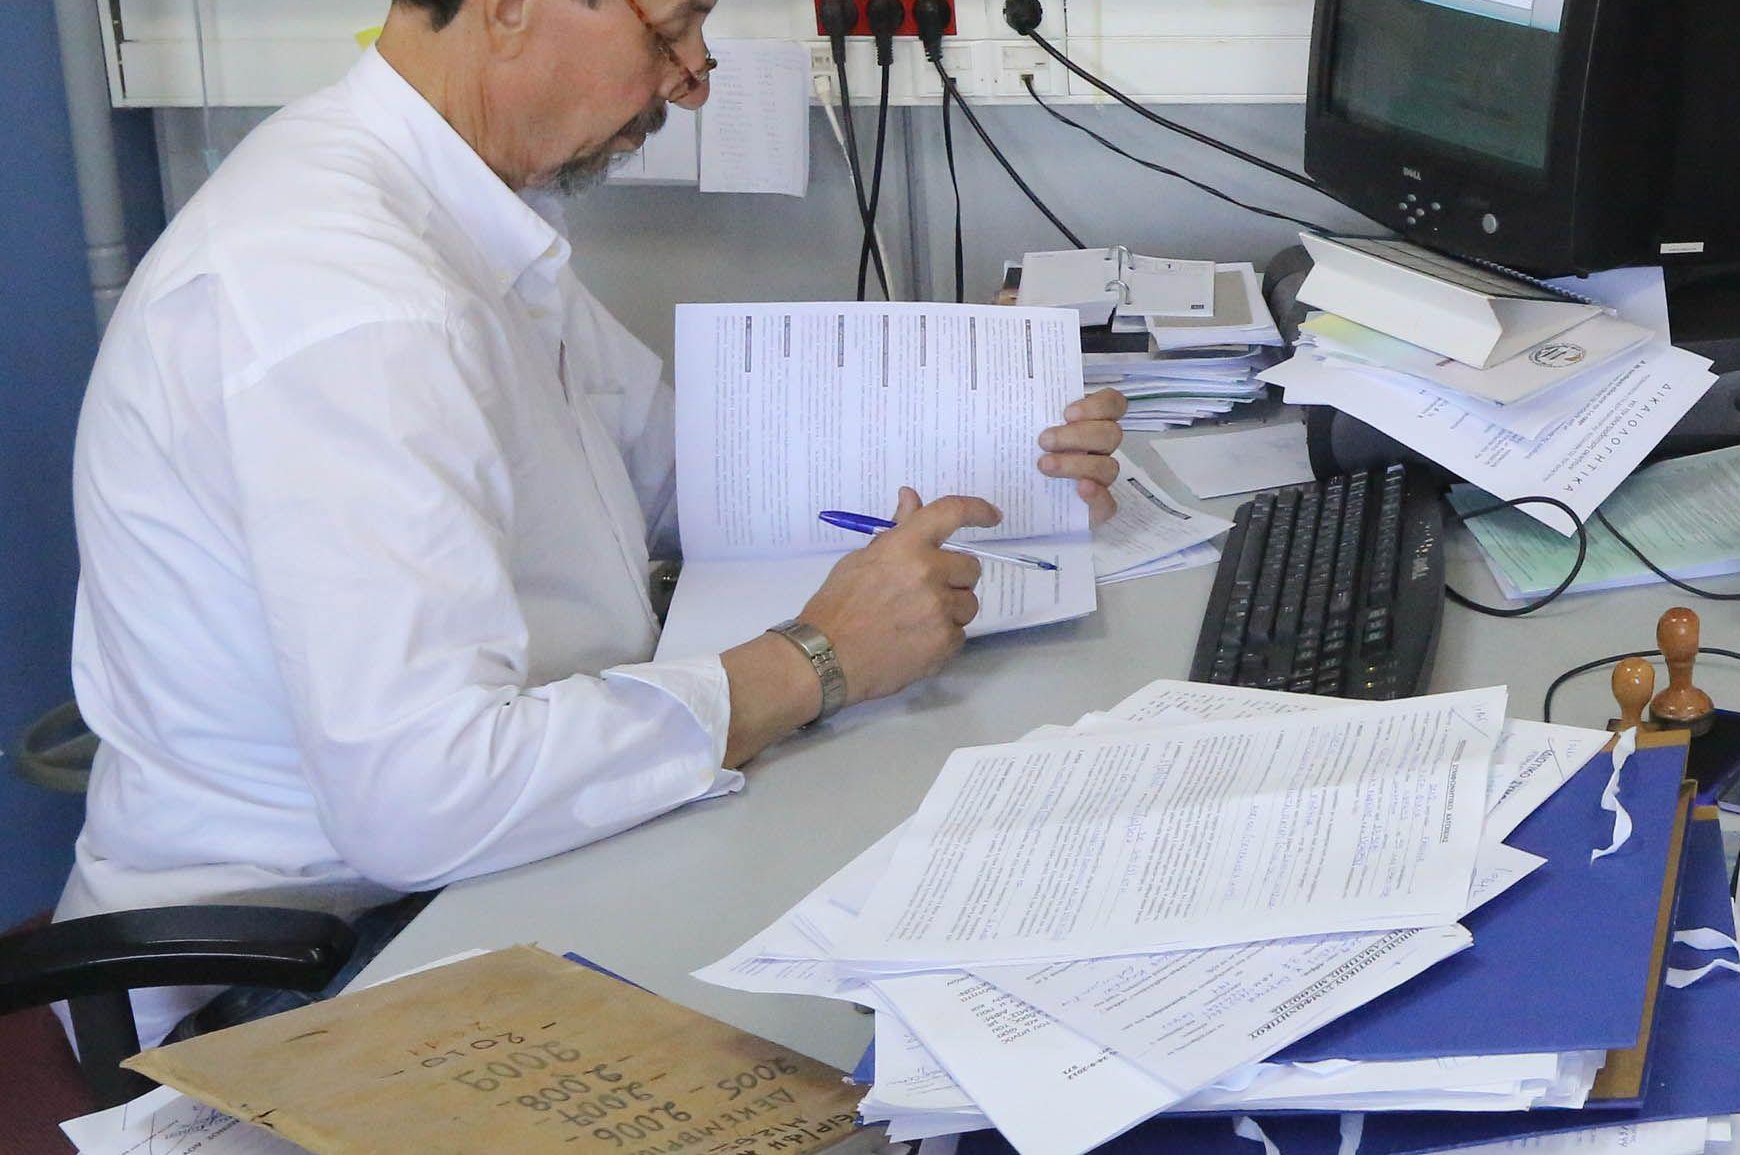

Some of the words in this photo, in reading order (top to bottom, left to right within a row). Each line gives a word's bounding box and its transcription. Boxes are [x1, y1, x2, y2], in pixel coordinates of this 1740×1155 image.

[421, 1031, 527, 1070] 2010
[451, 1039, 581, 1095] 2009
[517, 1063, 624, 1115] 2008
[717, 1057, 800, 1102] 2005
[559, 1080, 654, 1131] 2007
[591, 1102, 693, 1149] 2006
